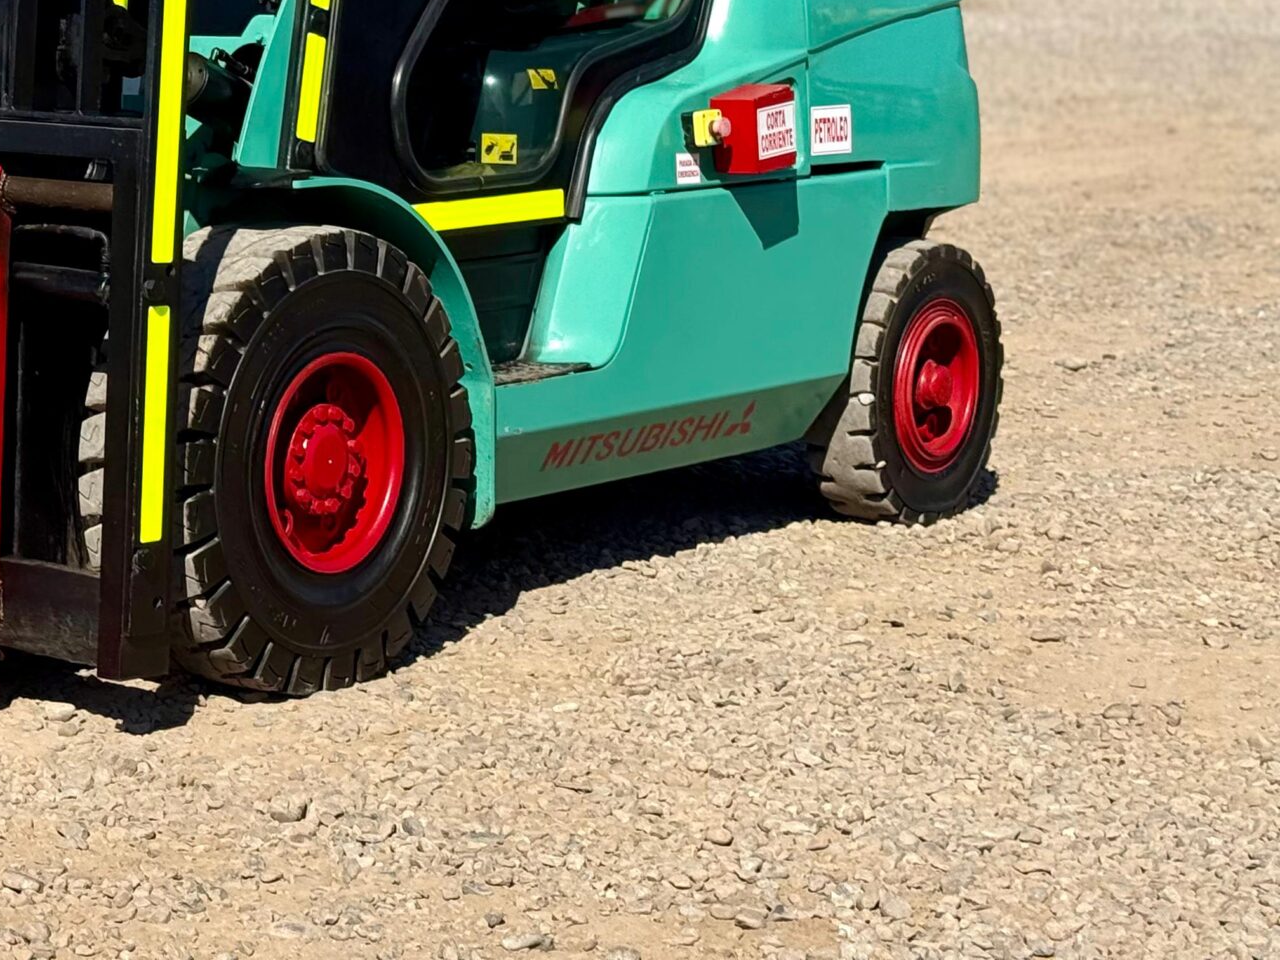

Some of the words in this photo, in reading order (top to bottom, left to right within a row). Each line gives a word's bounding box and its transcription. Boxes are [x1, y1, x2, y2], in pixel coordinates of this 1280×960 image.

[766, 110, 787, 130] CORTA
[814, 117, 848, 144] PETROLEO
[760, 129, 794, 154] CORRIENTE
[540, 410, 729, 472] MITSUBISHI
